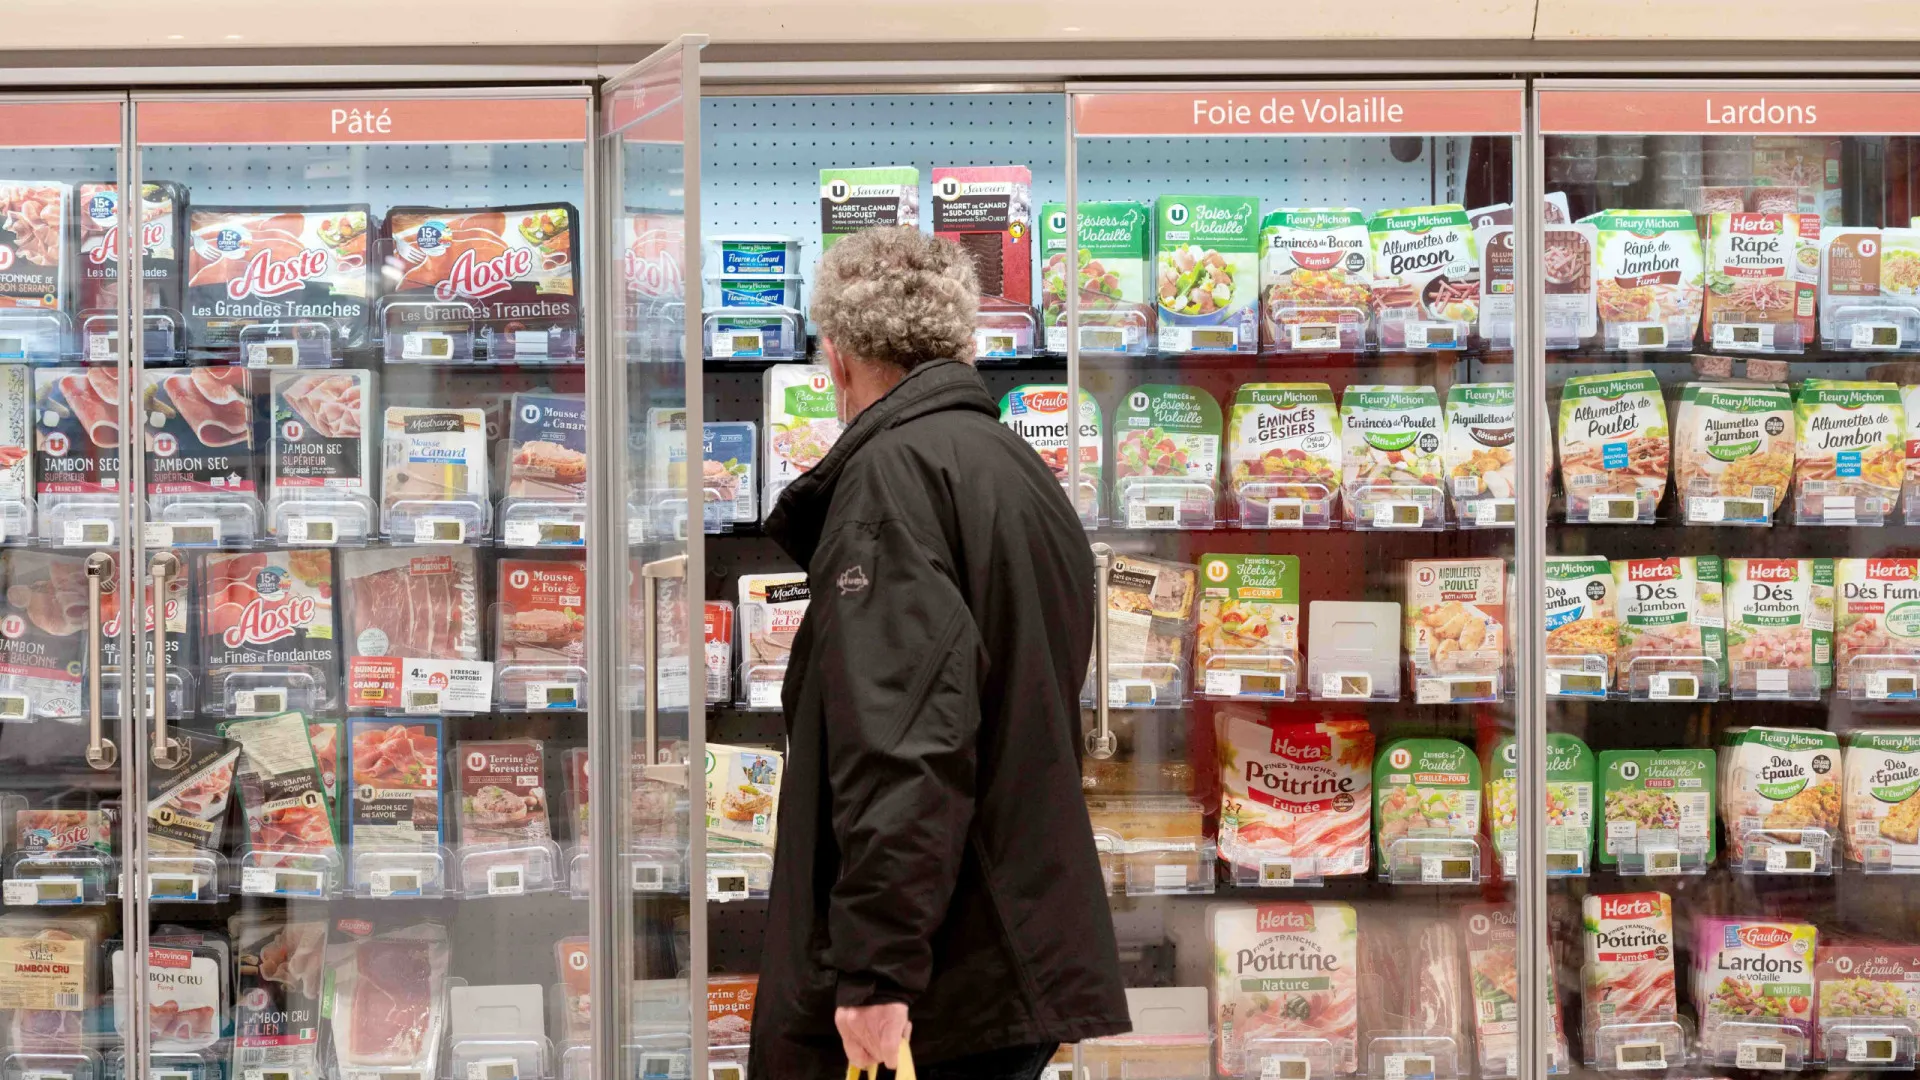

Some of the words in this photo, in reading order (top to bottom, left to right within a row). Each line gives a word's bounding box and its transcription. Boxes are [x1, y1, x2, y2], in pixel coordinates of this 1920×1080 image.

[1193, 99, 1251, 125] Foie
[1259, 98, 1295, 124] de
[1301, 97, 1404, 123] Volaille
[1706, 98, 1817, 124] Lardons
[330, 108, 393, 134] Pâté
[949, 209, 988, 217] SUD-OUEST
[979, 202, 1008, 210] CANARD
[1191, 220, 1243, 235] Volaille
[1286, 215, 1316, 229] Fleury
[1317, 213, 1351, 225] Michon
[1387, 217, 1416, 231] Fleury
[1416, 215, 1452, 227] Michon
[1615, 217, 1644, 232] Fleury
[1645, 217, 1680, 230] Michon
[1732, 216, 1775, 233] Herta
[1079, 227, 1132, 242] Volaille
[1382, 236, 1444, 256] Allumettes
[1445, 232, 1459, 243] de
[1623, 240, 1655, 257] Râpé
[1657, 240, 1671, 252] de
[1731, 235, 1779, 255] Râpé
[1390, 247, 1455, 275] Bacon
[1616, 256, 1681, 277] Jambon
[1725, 256, 1736, 265] de
[1736, 254, 1783, 267] Jambon
[229, 248, 328, 300] Aoste
[436, 250, 531, 301] Aoste
[1635, 276, 1661, 287] Fumé
[191, 305, 212, 317] Les
[215, 301, 282, 317] Grandes
[285, 300, 361, 317] Tranches
[401, 311, 421, 322] Les
[424, 303, 491, 321] Grandes
[493, 301, 571, 318] Tranches
[1579, 382, 1609, 398] Fleury
[1609, 379, 1644, 394] Michon
[1252, 391, 1283, 406] Fleury
[1284, 391, 1318, 403] Michon
[1359, 393, 1390, 408] Fleury
[1390, 393, 1424, 405] Michon
[1711, 394, 1742, 409] Fleury
[1742, 396, 1777, 409] Michon
[1818, 391, 1849, 406] Fleury
[1849, 390, 1885, 404] Michon
[543, 406, 579, 419] Mousse
[1155, 410, 1203, 425] Volaille
[1574, 401, 1636, 423] Allumettes
[1637, 397, 1651, 409] de
[410, 416, 460, 432] Madrange
[1257, 408, 1316, 430] ÉMINCÉS
[1588, 413, 1640, 439] Poulet
[1704, 417, 1759, 432] Allumettes
[1812, 413, 1874, 432] Allumettes
[1875, 412, 1890, 424] de
[1258, 422, 1316, 443] GÉSIERS
[1704, 433, 1713, 441] de
[1713, 428, 1760, 446] Jambon
[411, 438, 441, 448] Mousse
[1817, 431, 1883, 450] Jambon
[282, 443, 323, 456] JAMBON
[326, 442, 342, 456] SEC
[409, 448, 420, 458] de
[420, 446, 467, 459] Canard
[44, 458, 94, 472] JAMBON
[99, 457, 120, 472] SEC
[154, 457, 203, 472] JAMBON
[207, 456, 229, 471] SEC
[282, 455, 327, 467] SUPÉRIEUR
[282, 465, 311, 476] dégraissé
[44, 483, 53, 494] 4
[155, 484, 164, 495] 6
[532, 570, 574, 583] Mousse
[1438, 566, 1482, 580] AIGUILLETTES
[1631, 562, 1673, 578] Herta
[1749, 564, 1791, 579] Herta
[1868, 562, 1911, 578] Herta
[532, 585, 541, 593] de
[542, 583, 564, 594] Foie
[1240, 574, 1277, 588] Poulet
[1635, 582, 1678, 601] Dés
[1752, 582, 1794, 601] Dés
[772, 606, 801, 616] Mousse
[1627, 605, 1639, 614] de
[1638, 601, 1687, 615] Jambon
[1743, 604, 1754, 613] de
[1754, 602, 1800, 616] Jambon
[226, 599, 316, 646] Aoste
[1642, 615, 1676, 623] NATURE
[1757, 614, 1791, 622] NATURE
[11, 652, 59, 669] BAYONNE
[210, 654, 223, 664] Les
[224, 651, 257, 664] Fines
[257, 655, 265, 663] et
[267, 648, 332, 663] Fondantes
[353, 680, 380, 689] GRAND
[380, 680, 395, 689] JEU
[1760, 731, 1790, 746] Fleury
[1790, 734, 1824, 746] Michon
[1274, 739, 1322, 759] Herta
[489, 753, 525, 765] Terrine
[1419, 758, 1457, 772] Poulet
[1770, 755, 1793, 768] Dés
[1884, 758, 1907, 772] Dés
[489, 762, 540, 775] Forestière
[1263, 762, 1288, 772] FINES
[1289, 762, 1339, 779] TRANCHES
[1645, 765, 1693, 778] Volaille
[1245, 760, 1356, 796] Poitrine
[361, 804, 388, 812] JAMBON
[1272, 797, 1321, 813] Fumée
[371, 811, 397, 819] SAVOIE
[1604, 900, 1653, 917] Herta
[1259, 911, 1306, 930] Herta
[1596, 932, 1669, 950] Poitrine
[1736, 929, 1746, 941] le
[1746, 926, 1791, 947] Gaulois
[1253, 936, 1274, 958] FINES
[1274, 934, 1323, 954] TRANCHES
[154, 949, 189, 962] Provinces
[1236, 946, 1341, 975] Poitrine
[1615, 952, 1649, 963] Fumée
[1717, 951, 1804, 975] Lardons
[14, 963, 51, 974] JAMBON
[52, 963, 70, 975] CRU
[1853, 962, 1905, 981] d'Épaule
[1736, 973, 1746, 982] de
[1746, 971, 1782, 983] Volaille
[1262, 978, 1311, 992] Nature
[1772, 985, 1803, 997] NATURE
[1601, 985, 1614, 1003] 7
[291, 1010, 310, 1024] CRU
